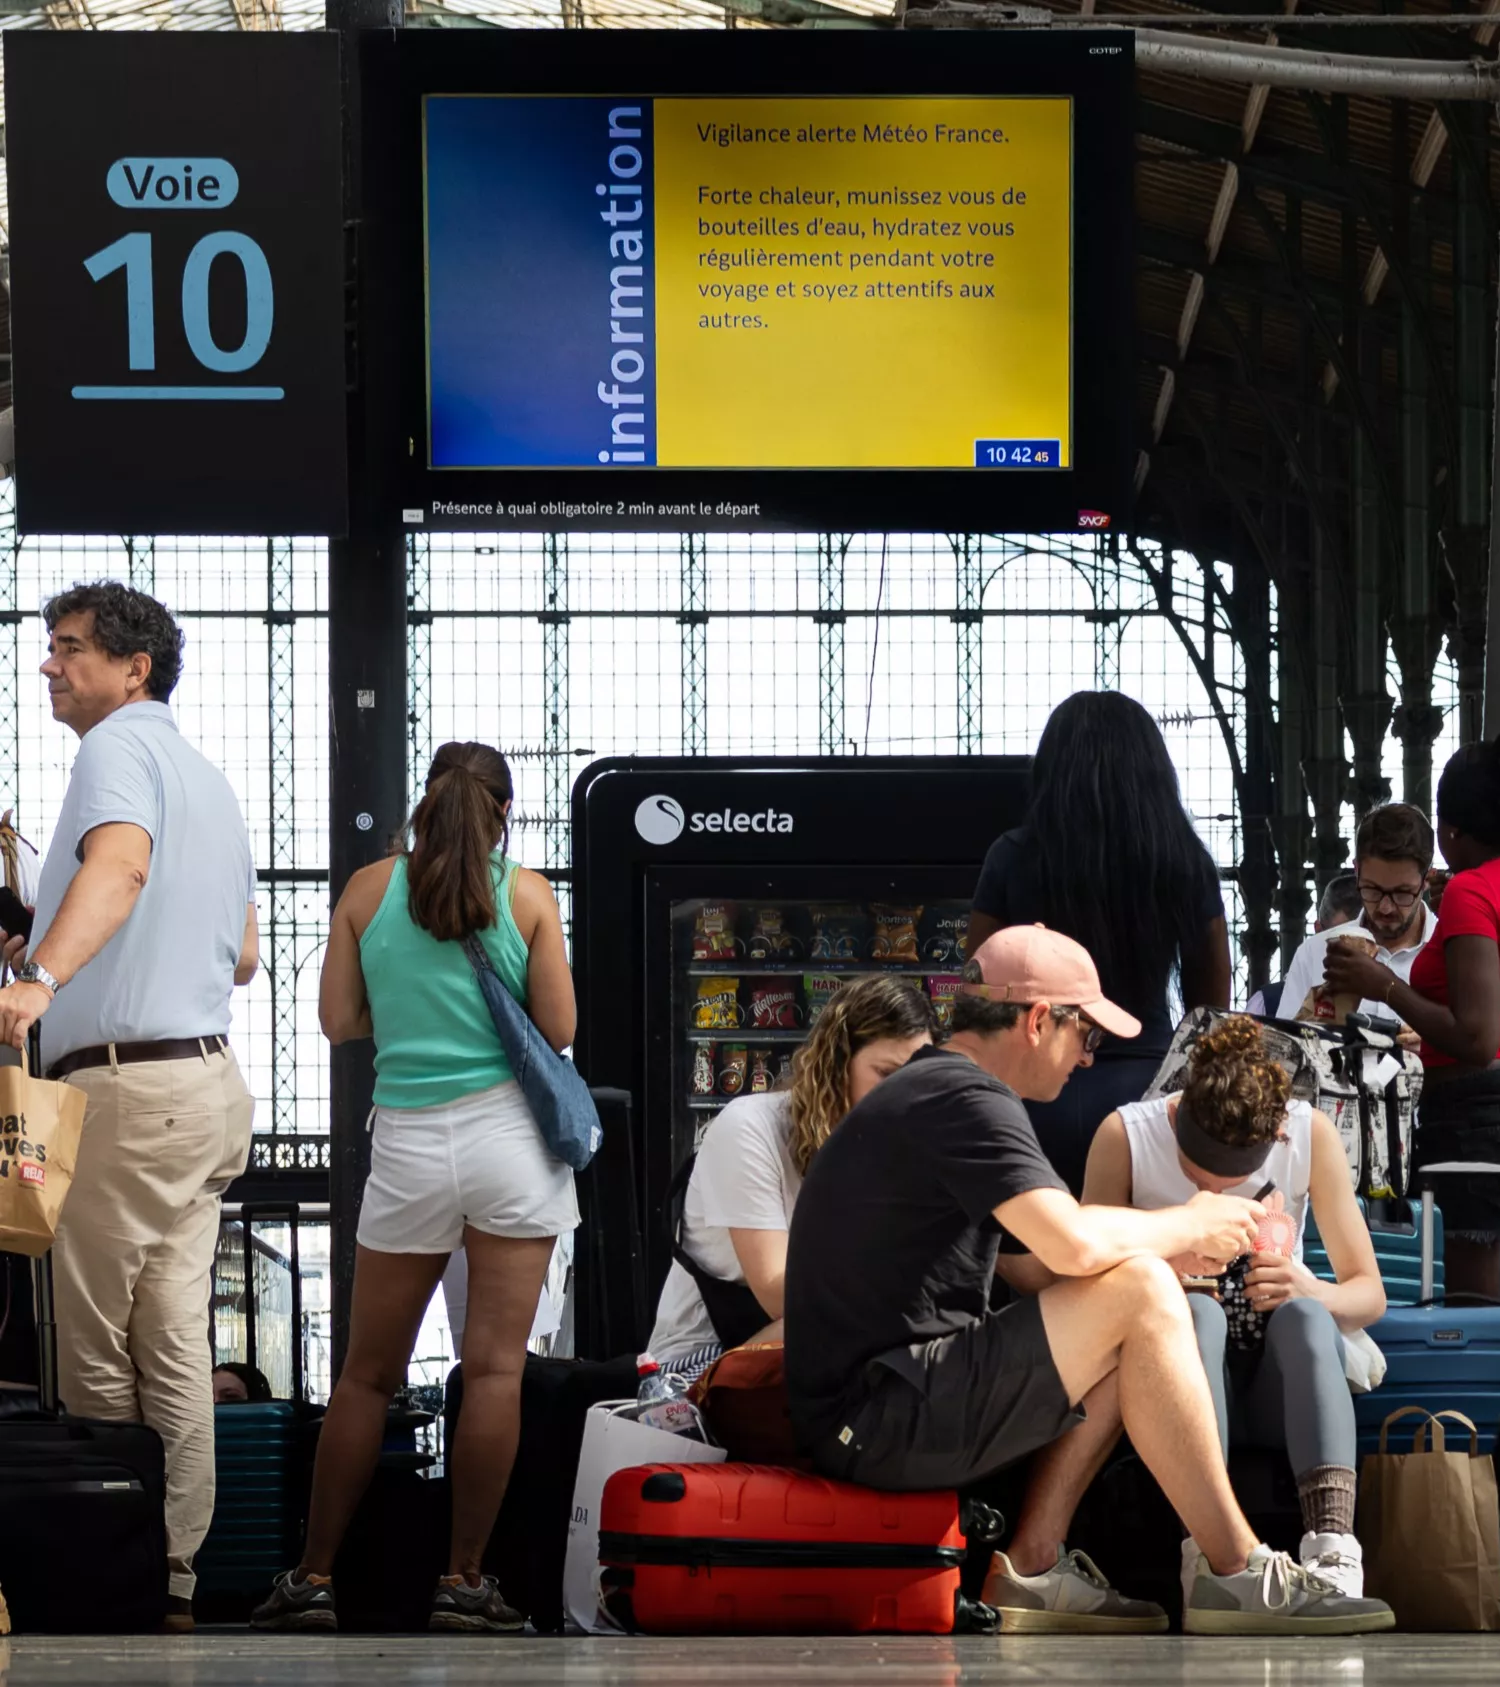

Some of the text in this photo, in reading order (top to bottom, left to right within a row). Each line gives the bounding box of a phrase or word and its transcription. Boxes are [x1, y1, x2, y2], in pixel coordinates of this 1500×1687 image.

[698, 124, 1009, 147] Vigilance alerte Météo France.
[123, 164, 220, 202] Voie
[699, 186, 1026, 208] Forte chaleur, munissez vous de
[699, 218, 1015, 241] bouteilles d'eau, hydratez vous
[700, 249, 994, 271] régulièrement pendant votre
[596, 105, 646, 465] information
[699, 280, 995, 302] voyage et soyez attentifs aux
[82, 231, 274, 373] 10
[698, 313, 768, 329] autres.
[987, 447, 1049, 463] 10 42 45
[432, 501, 761, 518] Présence à quai obligatoire 2 min avant le départ
[1078, 515, 1109, 526] SNCF
[690, 807, 794, 833] selecta
[936, 918, 968, 929] Dorito
[812, 979, 843, 991] HARI
[0, 1112, 27, 1136] at
[0, 1138, 47, 1162] ves
[666, 1403, 688, 1416] evia
